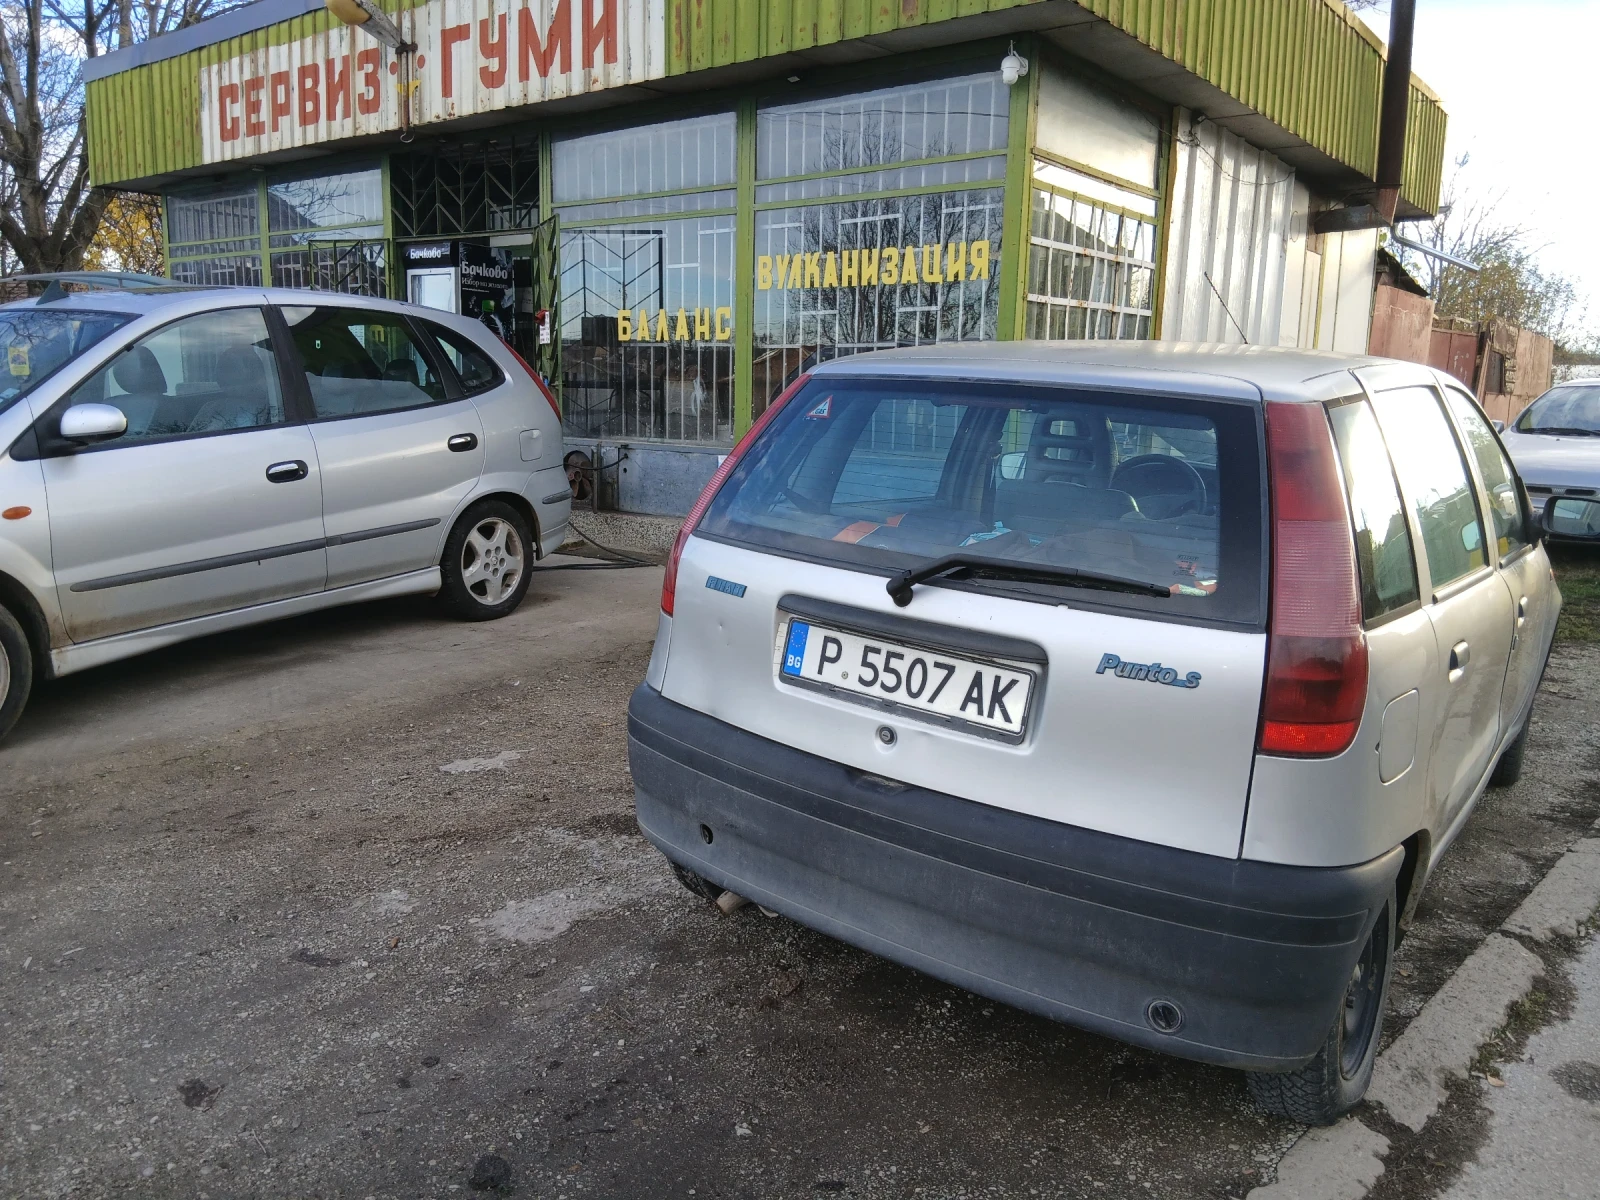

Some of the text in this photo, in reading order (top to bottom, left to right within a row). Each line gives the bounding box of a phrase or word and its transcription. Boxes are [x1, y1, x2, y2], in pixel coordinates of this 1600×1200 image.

[219, 0, 618, 142] СЕРВИЗ ГУМИ
[410, 247, 442, 260] Бачково
[461, 261, 508, 280] Бачково
[757, 240, 990, 290] ВУЛКАНИЗАЦИЯ
[617, 306, 732, 342] БАЛАНС
[787, 654, 801, 668] BG
[817, 635, 1020, 724] P 5507 AK
